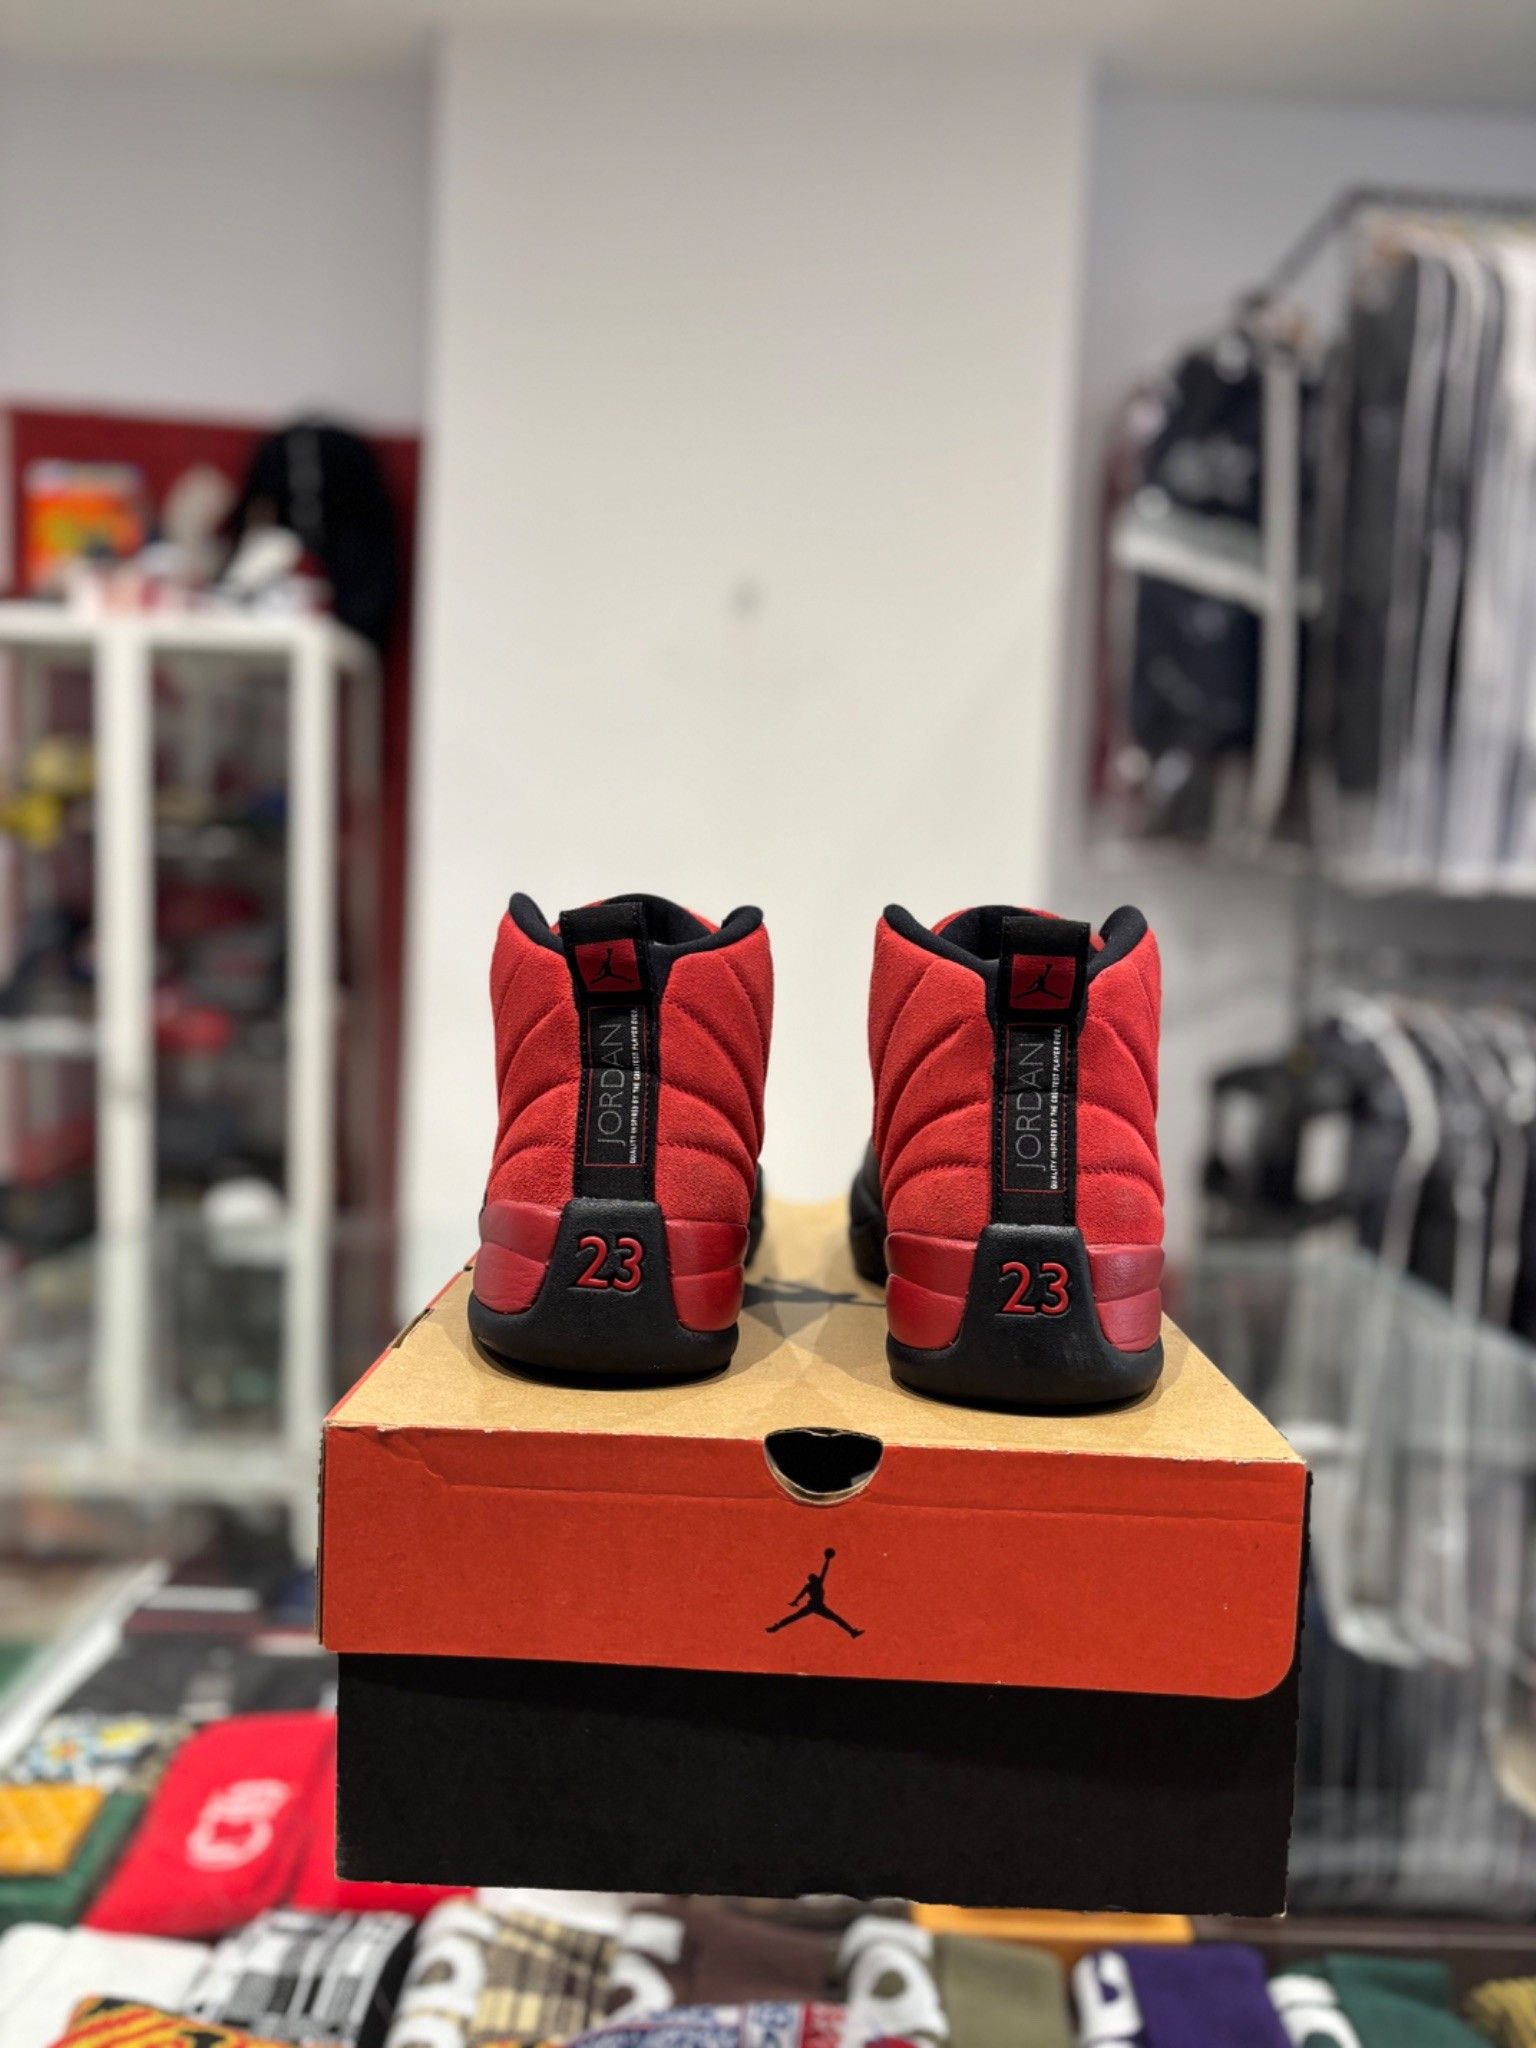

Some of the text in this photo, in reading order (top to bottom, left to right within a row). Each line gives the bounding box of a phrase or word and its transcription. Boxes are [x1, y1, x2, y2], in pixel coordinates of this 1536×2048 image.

[597, 1024, 626, 1147] JORDAN
[1015, 1043, 1045, 1172] JORDAN
[1050, 1160, 1059, 1190] QUALITY
[576, 1235, 643, 1292] 23
[1001, 1261, 1069, 1314] 23
